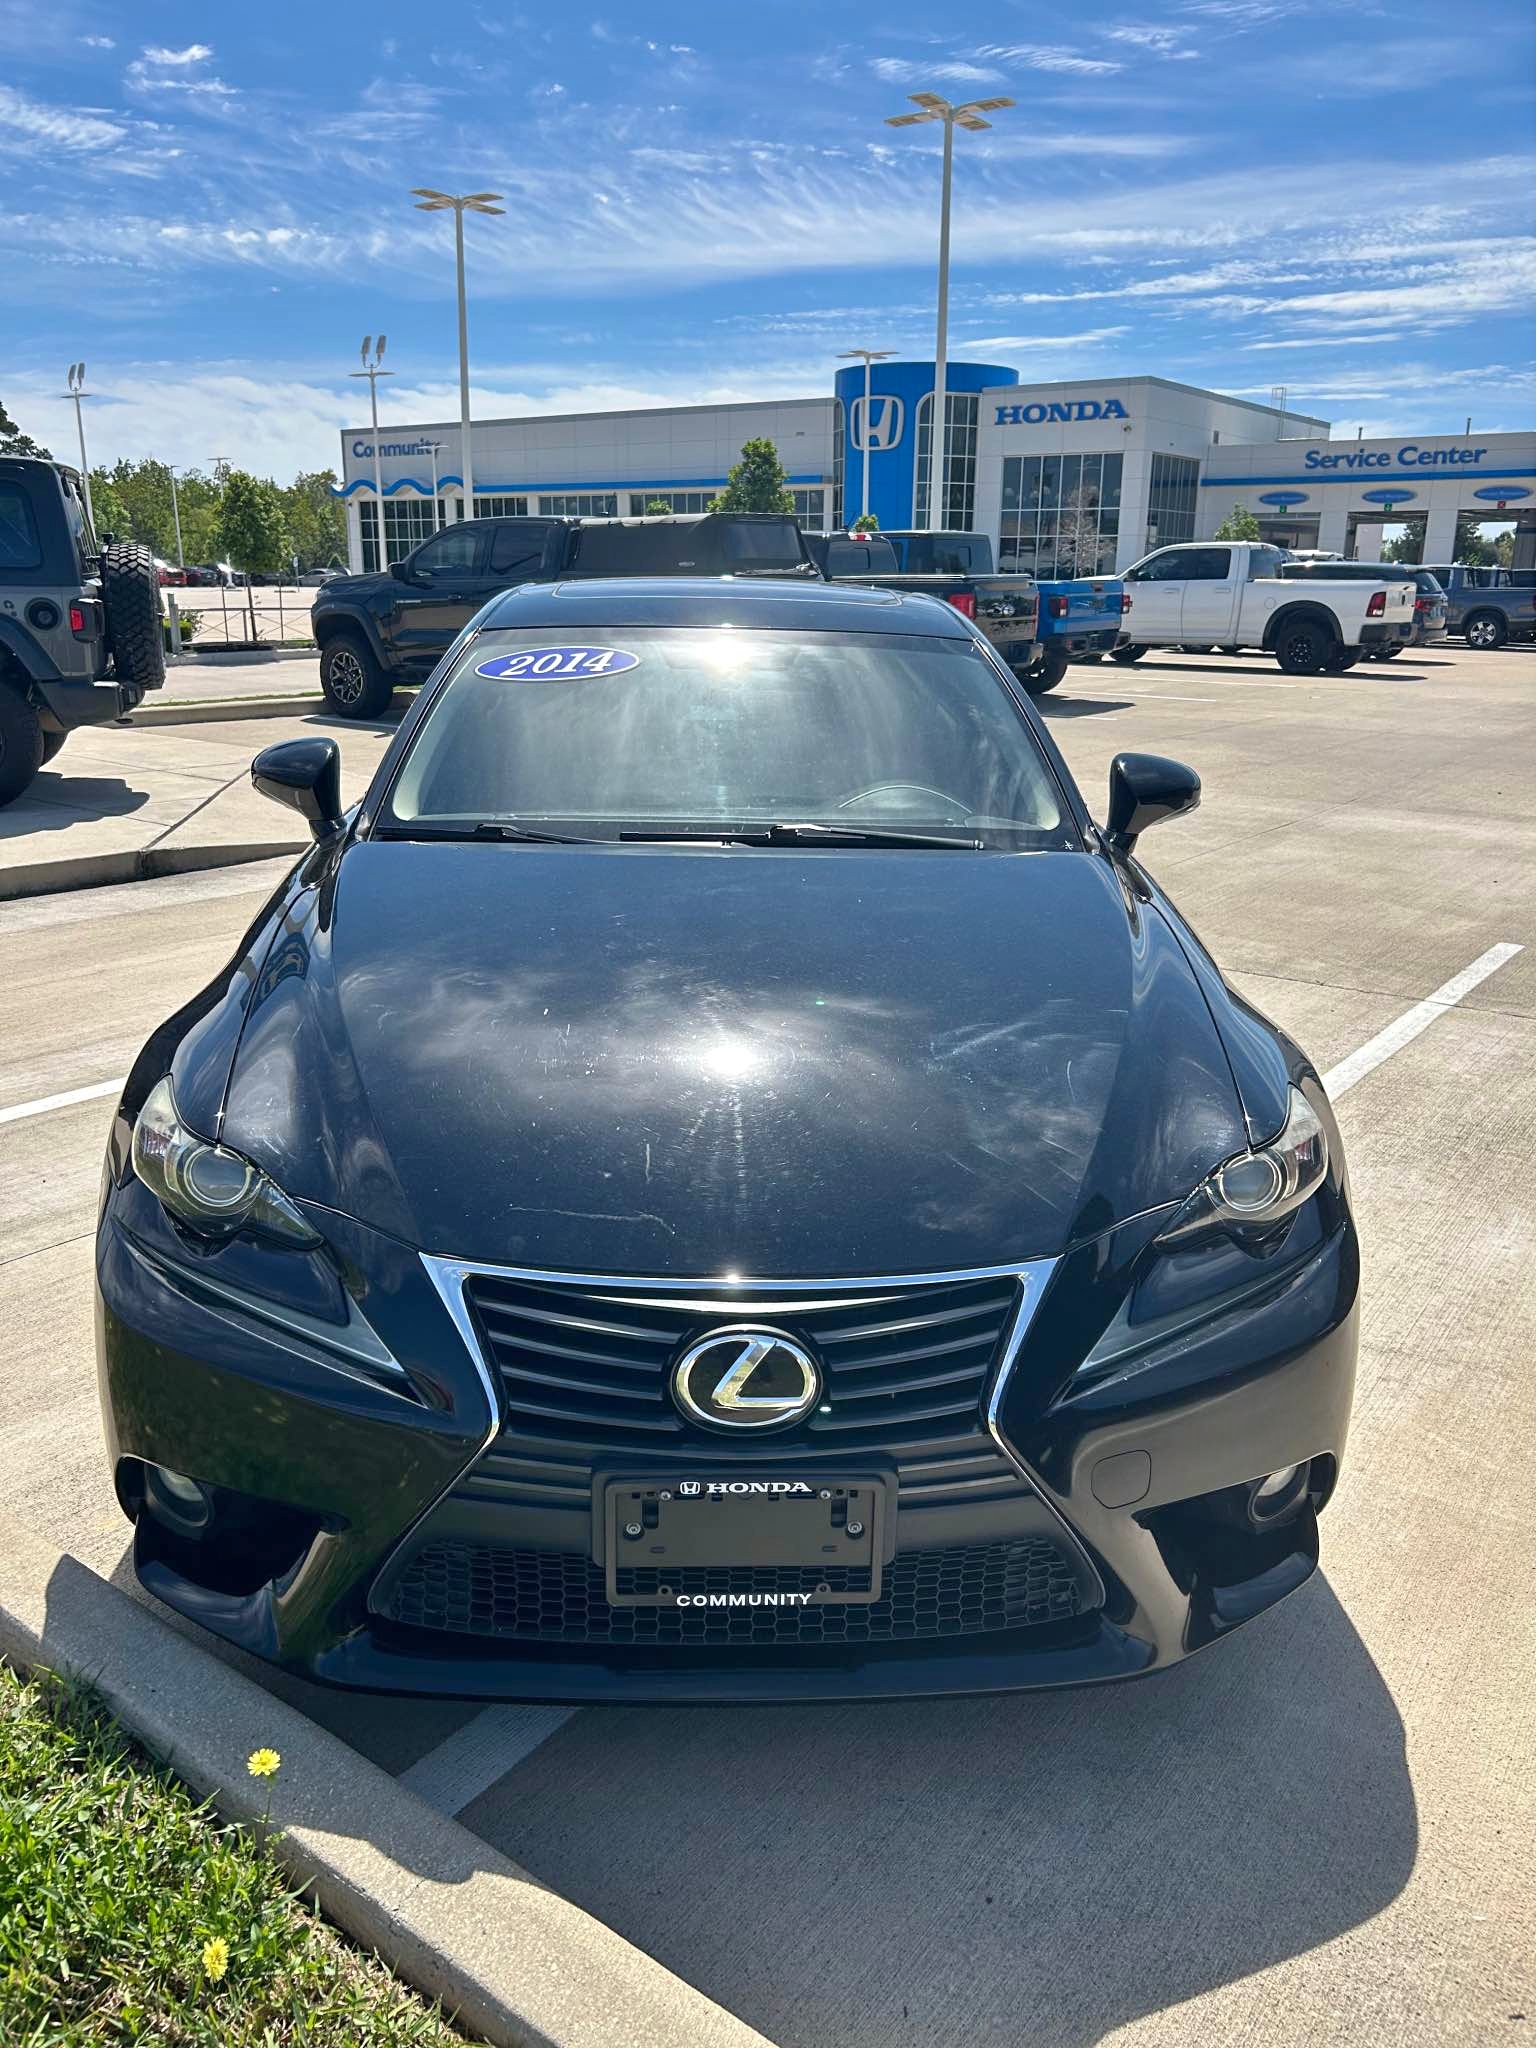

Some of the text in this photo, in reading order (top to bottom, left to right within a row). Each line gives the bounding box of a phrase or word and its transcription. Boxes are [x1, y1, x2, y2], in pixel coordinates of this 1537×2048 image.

[994, 399, 1129, 425] HONDA
[1304, 446, 1487, 470] Service Center
[499, 651, 615, 677] 2014
[706, 1482, 813, 1494] HONDA
[676, 1593, 812, 1607] COMMUNITY
